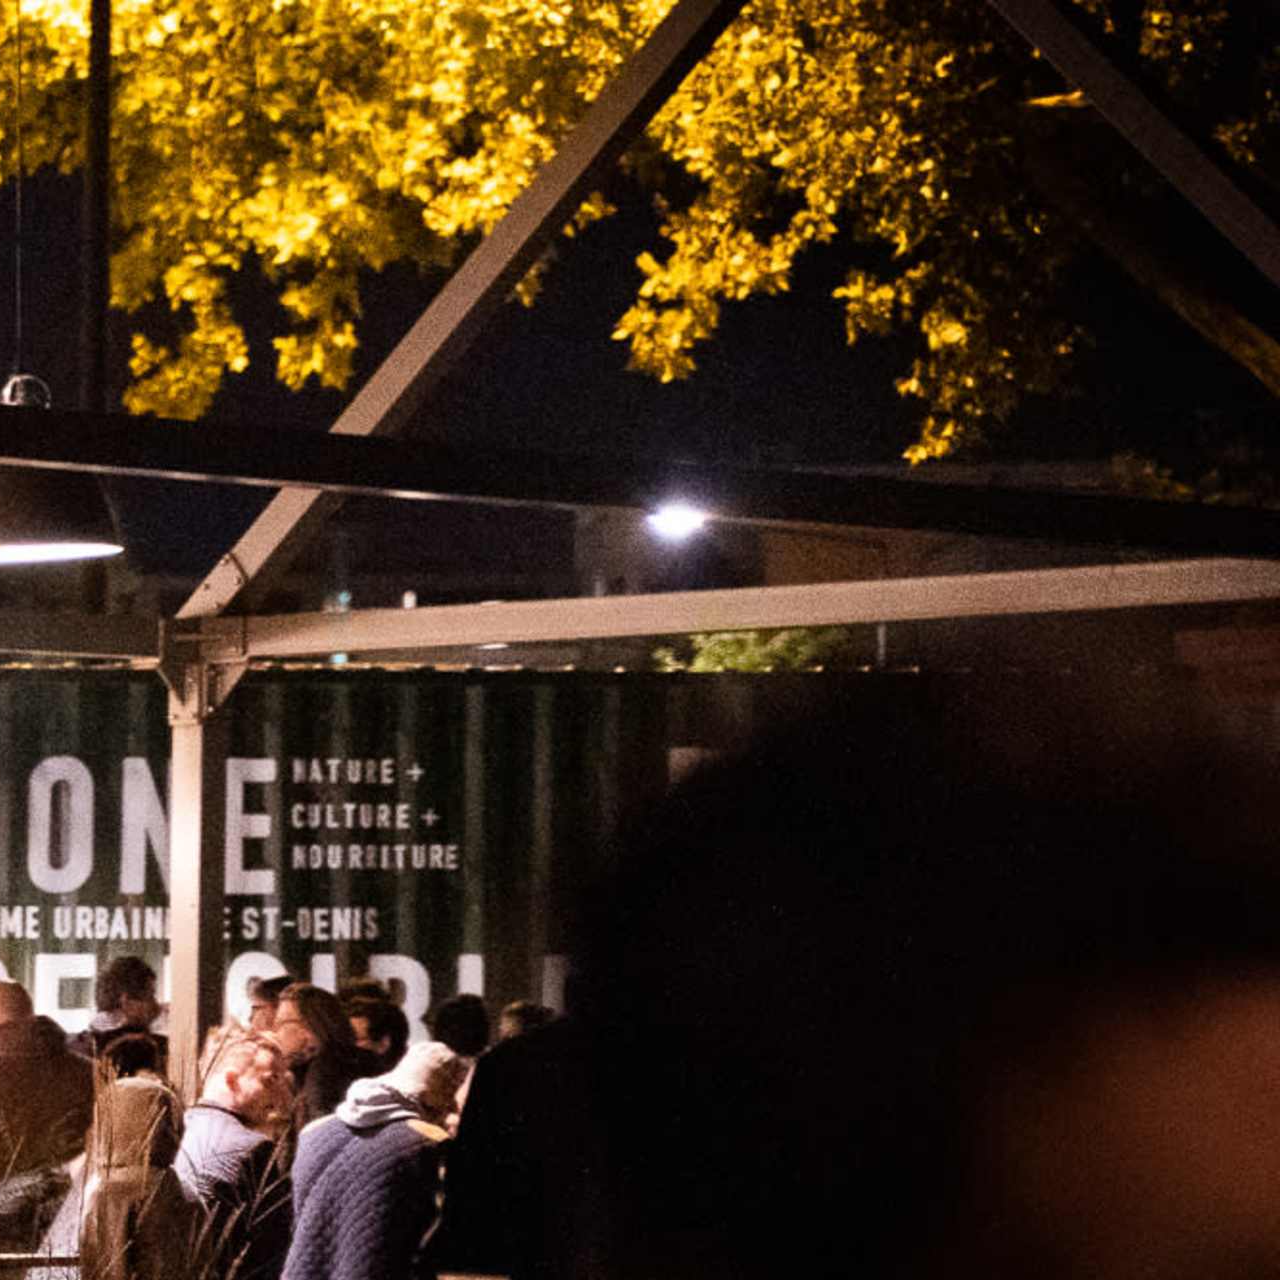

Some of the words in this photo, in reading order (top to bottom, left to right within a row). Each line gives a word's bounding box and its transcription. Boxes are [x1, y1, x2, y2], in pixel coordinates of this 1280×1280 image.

[292, 757, 395, 784] NATURE
[291, 803, 411, 829] CULTURE
[292, 844, 459, 870] NOURRITURE
[242, 906, 379, 941] ST-DENIS
